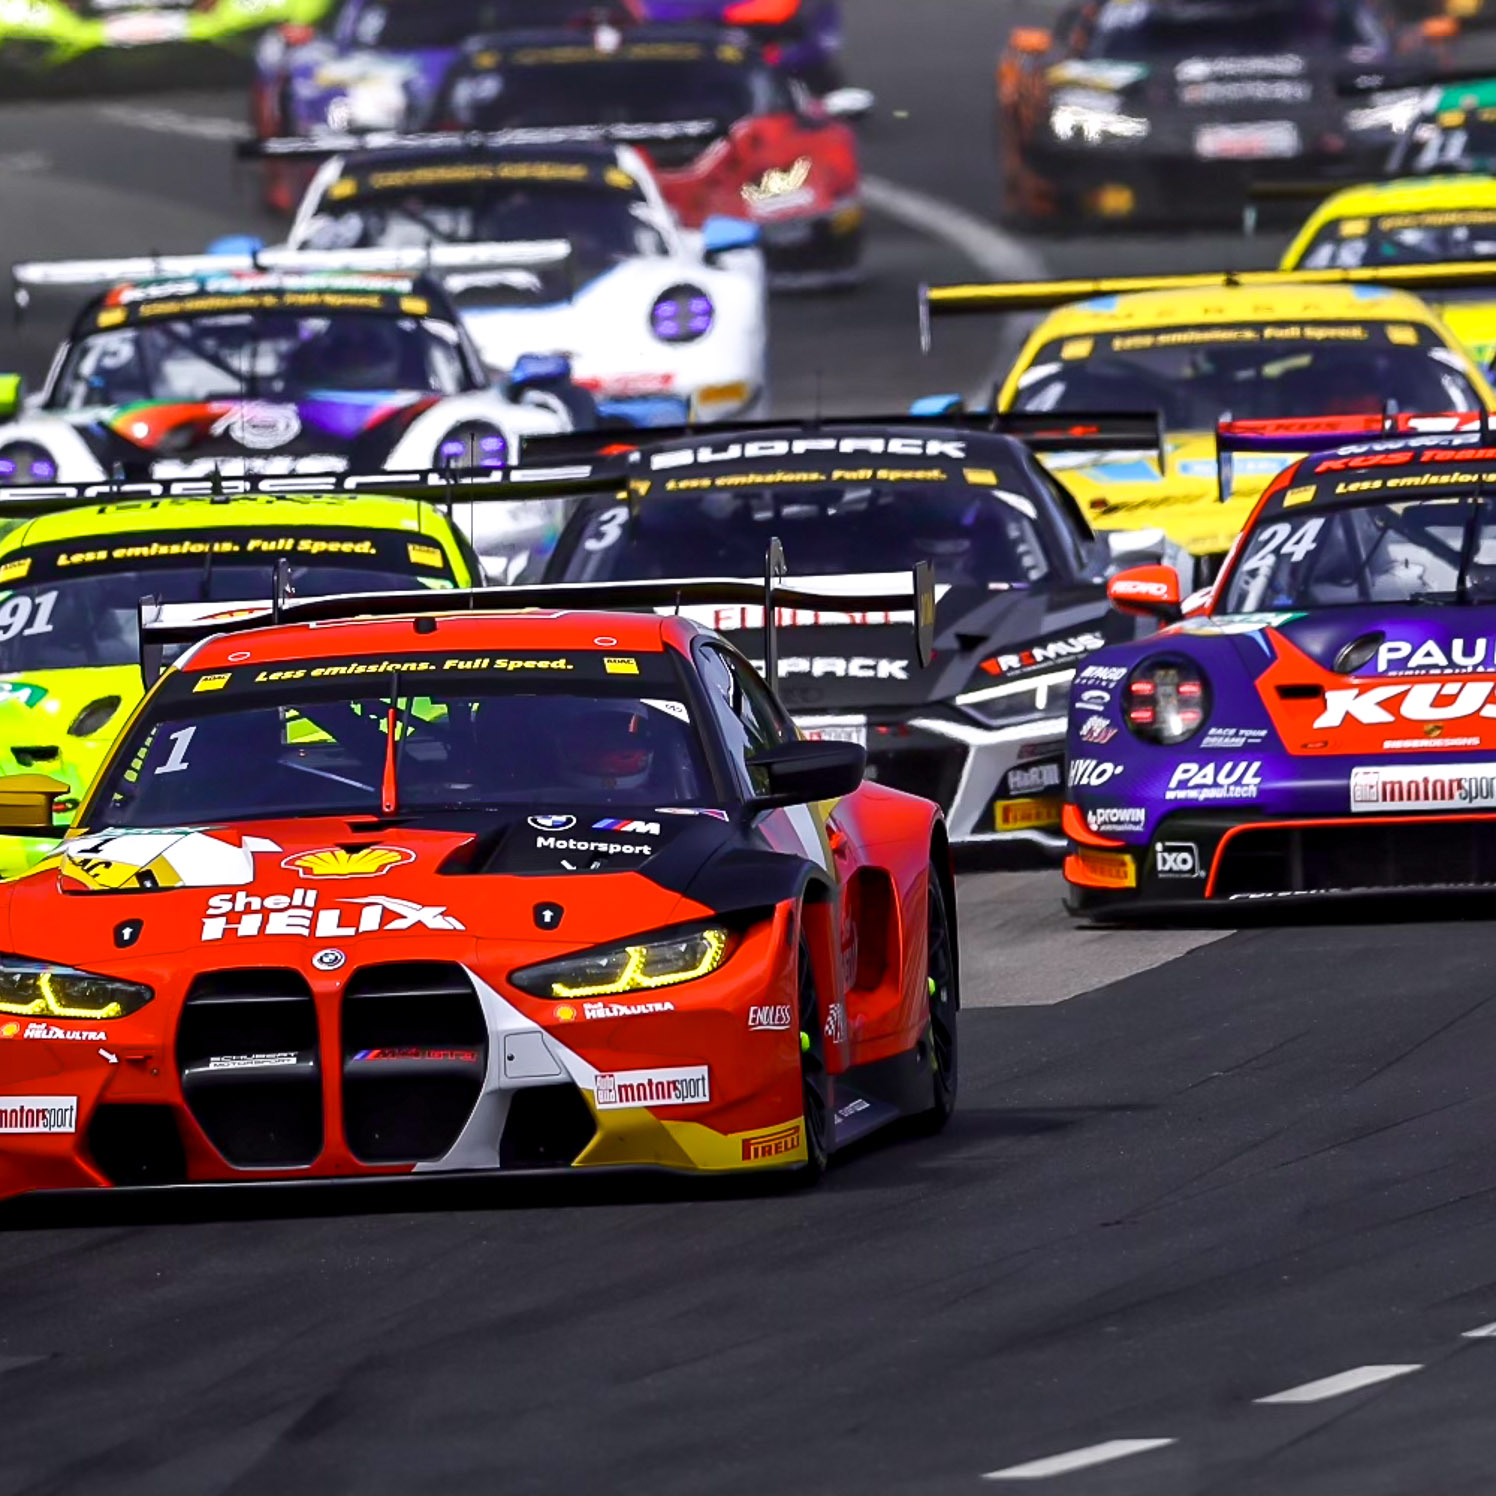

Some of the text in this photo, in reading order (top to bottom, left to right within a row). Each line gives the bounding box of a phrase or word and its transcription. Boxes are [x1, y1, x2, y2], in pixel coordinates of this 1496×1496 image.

[1334, 477, 1384, 494] Less
[584, 504, 630, 552] 3
[55, 536, 377, 568] Less emissions. Full Speed.
[1242, 517, 1327, 572] 24
[255, 657, 575, 683] Less emissions. Full Speed.
[154, 725, 197, 775] 1
[1167, 760, 1263, 789] PAUL
[1164, 785, 1258, 802] www.paul.tech
[535, 835, 653, 855] Motorsport
[1154, 841, 1195, 872] ixo
[205, 887, 318, 916] Shell
[200, 895, 467, 942] HELIX
[748, 1004, 792, 1032] ENDLESS
[65, 1029, 107, 1041] ULTRA
[618, 1073, 707, 1104] motorsport
[741, 1125, 801, 1162] PIRELLI
